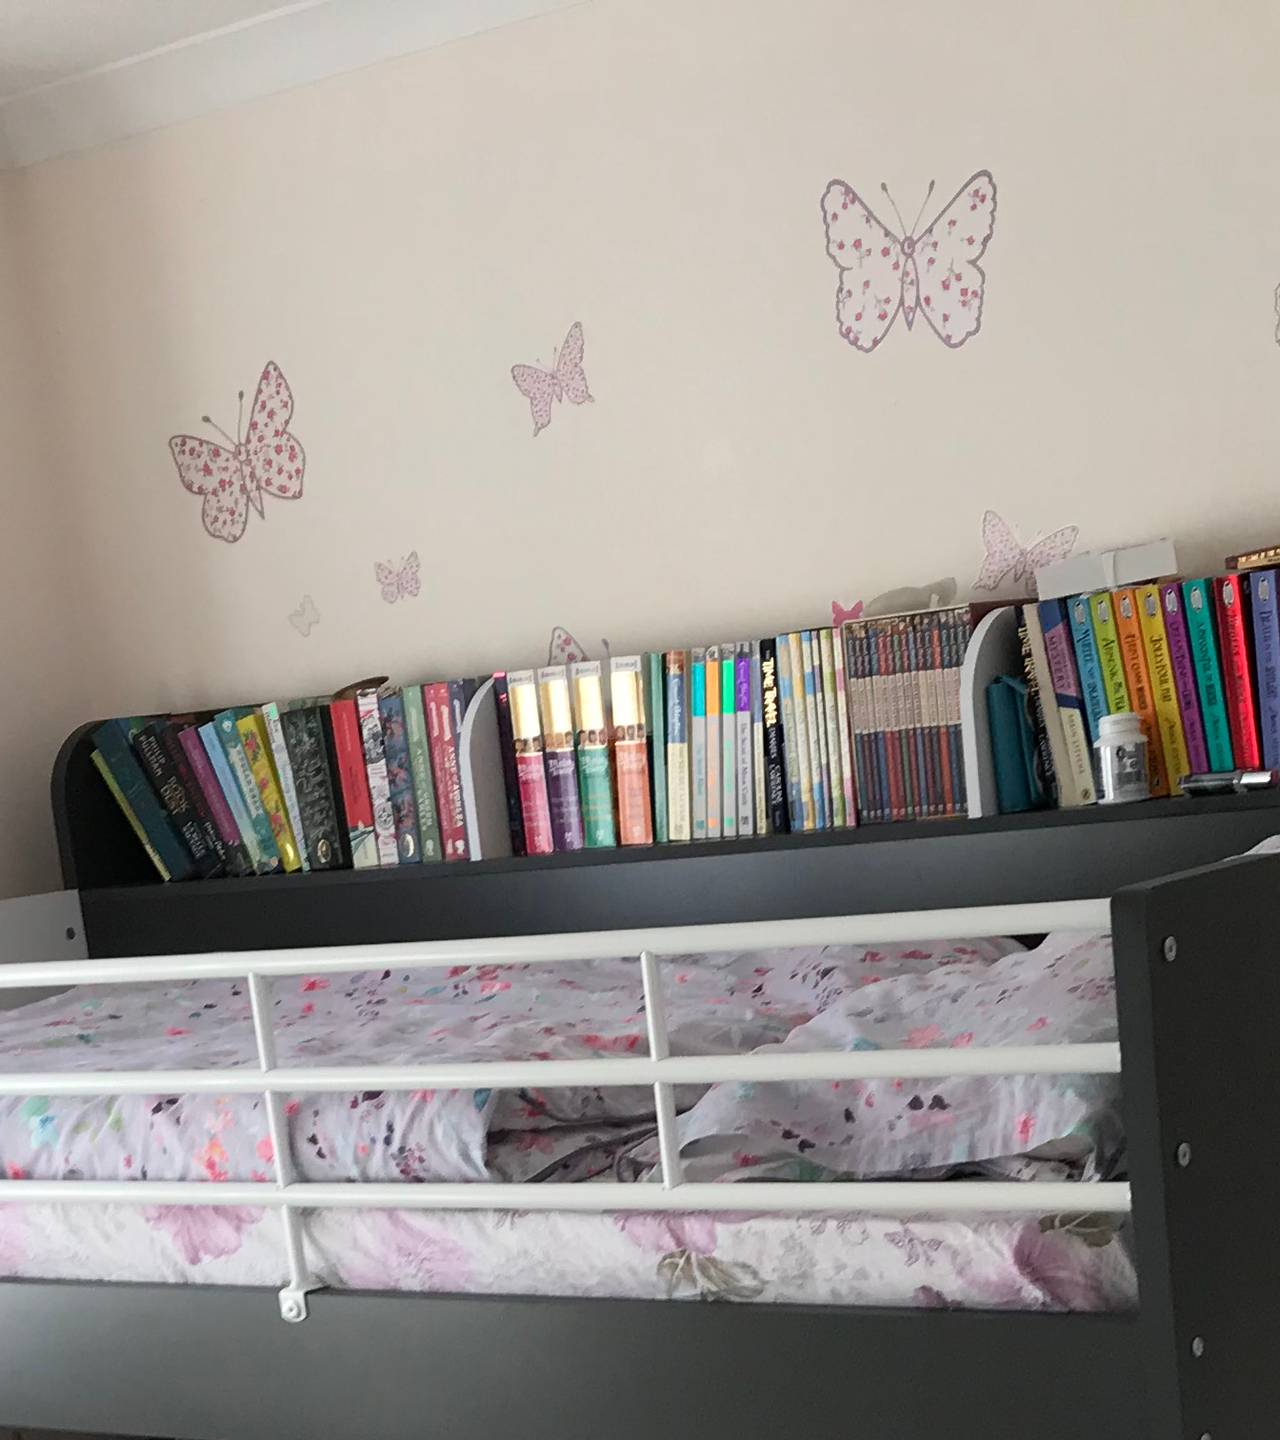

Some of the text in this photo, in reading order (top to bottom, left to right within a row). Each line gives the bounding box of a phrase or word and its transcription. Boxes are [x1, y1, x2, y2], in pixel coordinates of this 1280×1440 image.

[1258, 609, 1274, 642] DEATH
[1047, 634, 1066, 690] MYSTERY
[1148, 632, 1167, 666] JOLLY
[760, 656, 776, 688] TIME
[1154, 663, 1170, 688] FOUL
[762, 686, 779, 728] TRAVEL
[1113, 694, 1127, 711] TEA
[139, 734, 164, 778] PULLMAN
